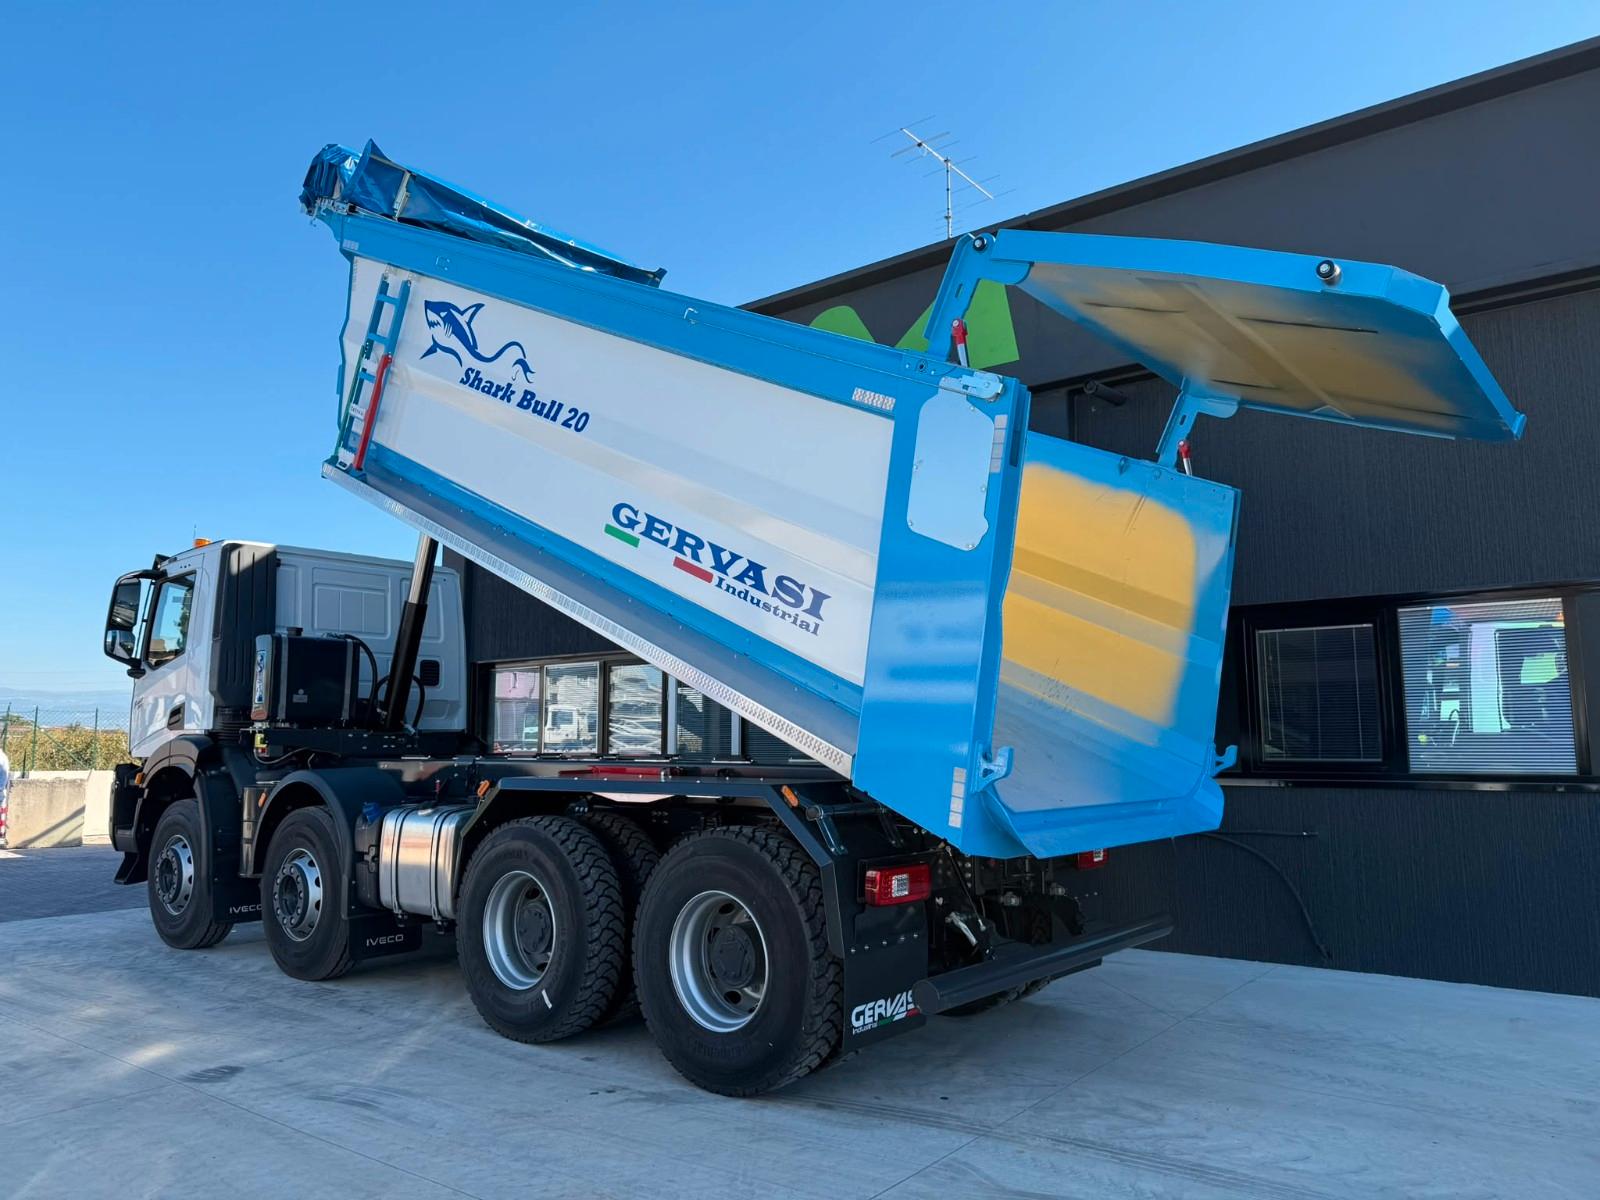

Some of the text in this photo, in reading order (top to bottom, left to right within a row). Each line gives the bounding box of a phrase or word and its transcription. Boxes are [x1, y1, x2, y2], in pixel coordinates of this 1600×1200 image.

[460, 367, 590, 432] Shark Bull 20
[611, 502, 832, 622] GERVASI
[714, 576, 821, 637] Industrial
[366, 934, 405, 947] IVECO
[851, 990, 917, 1028] GERVAS
